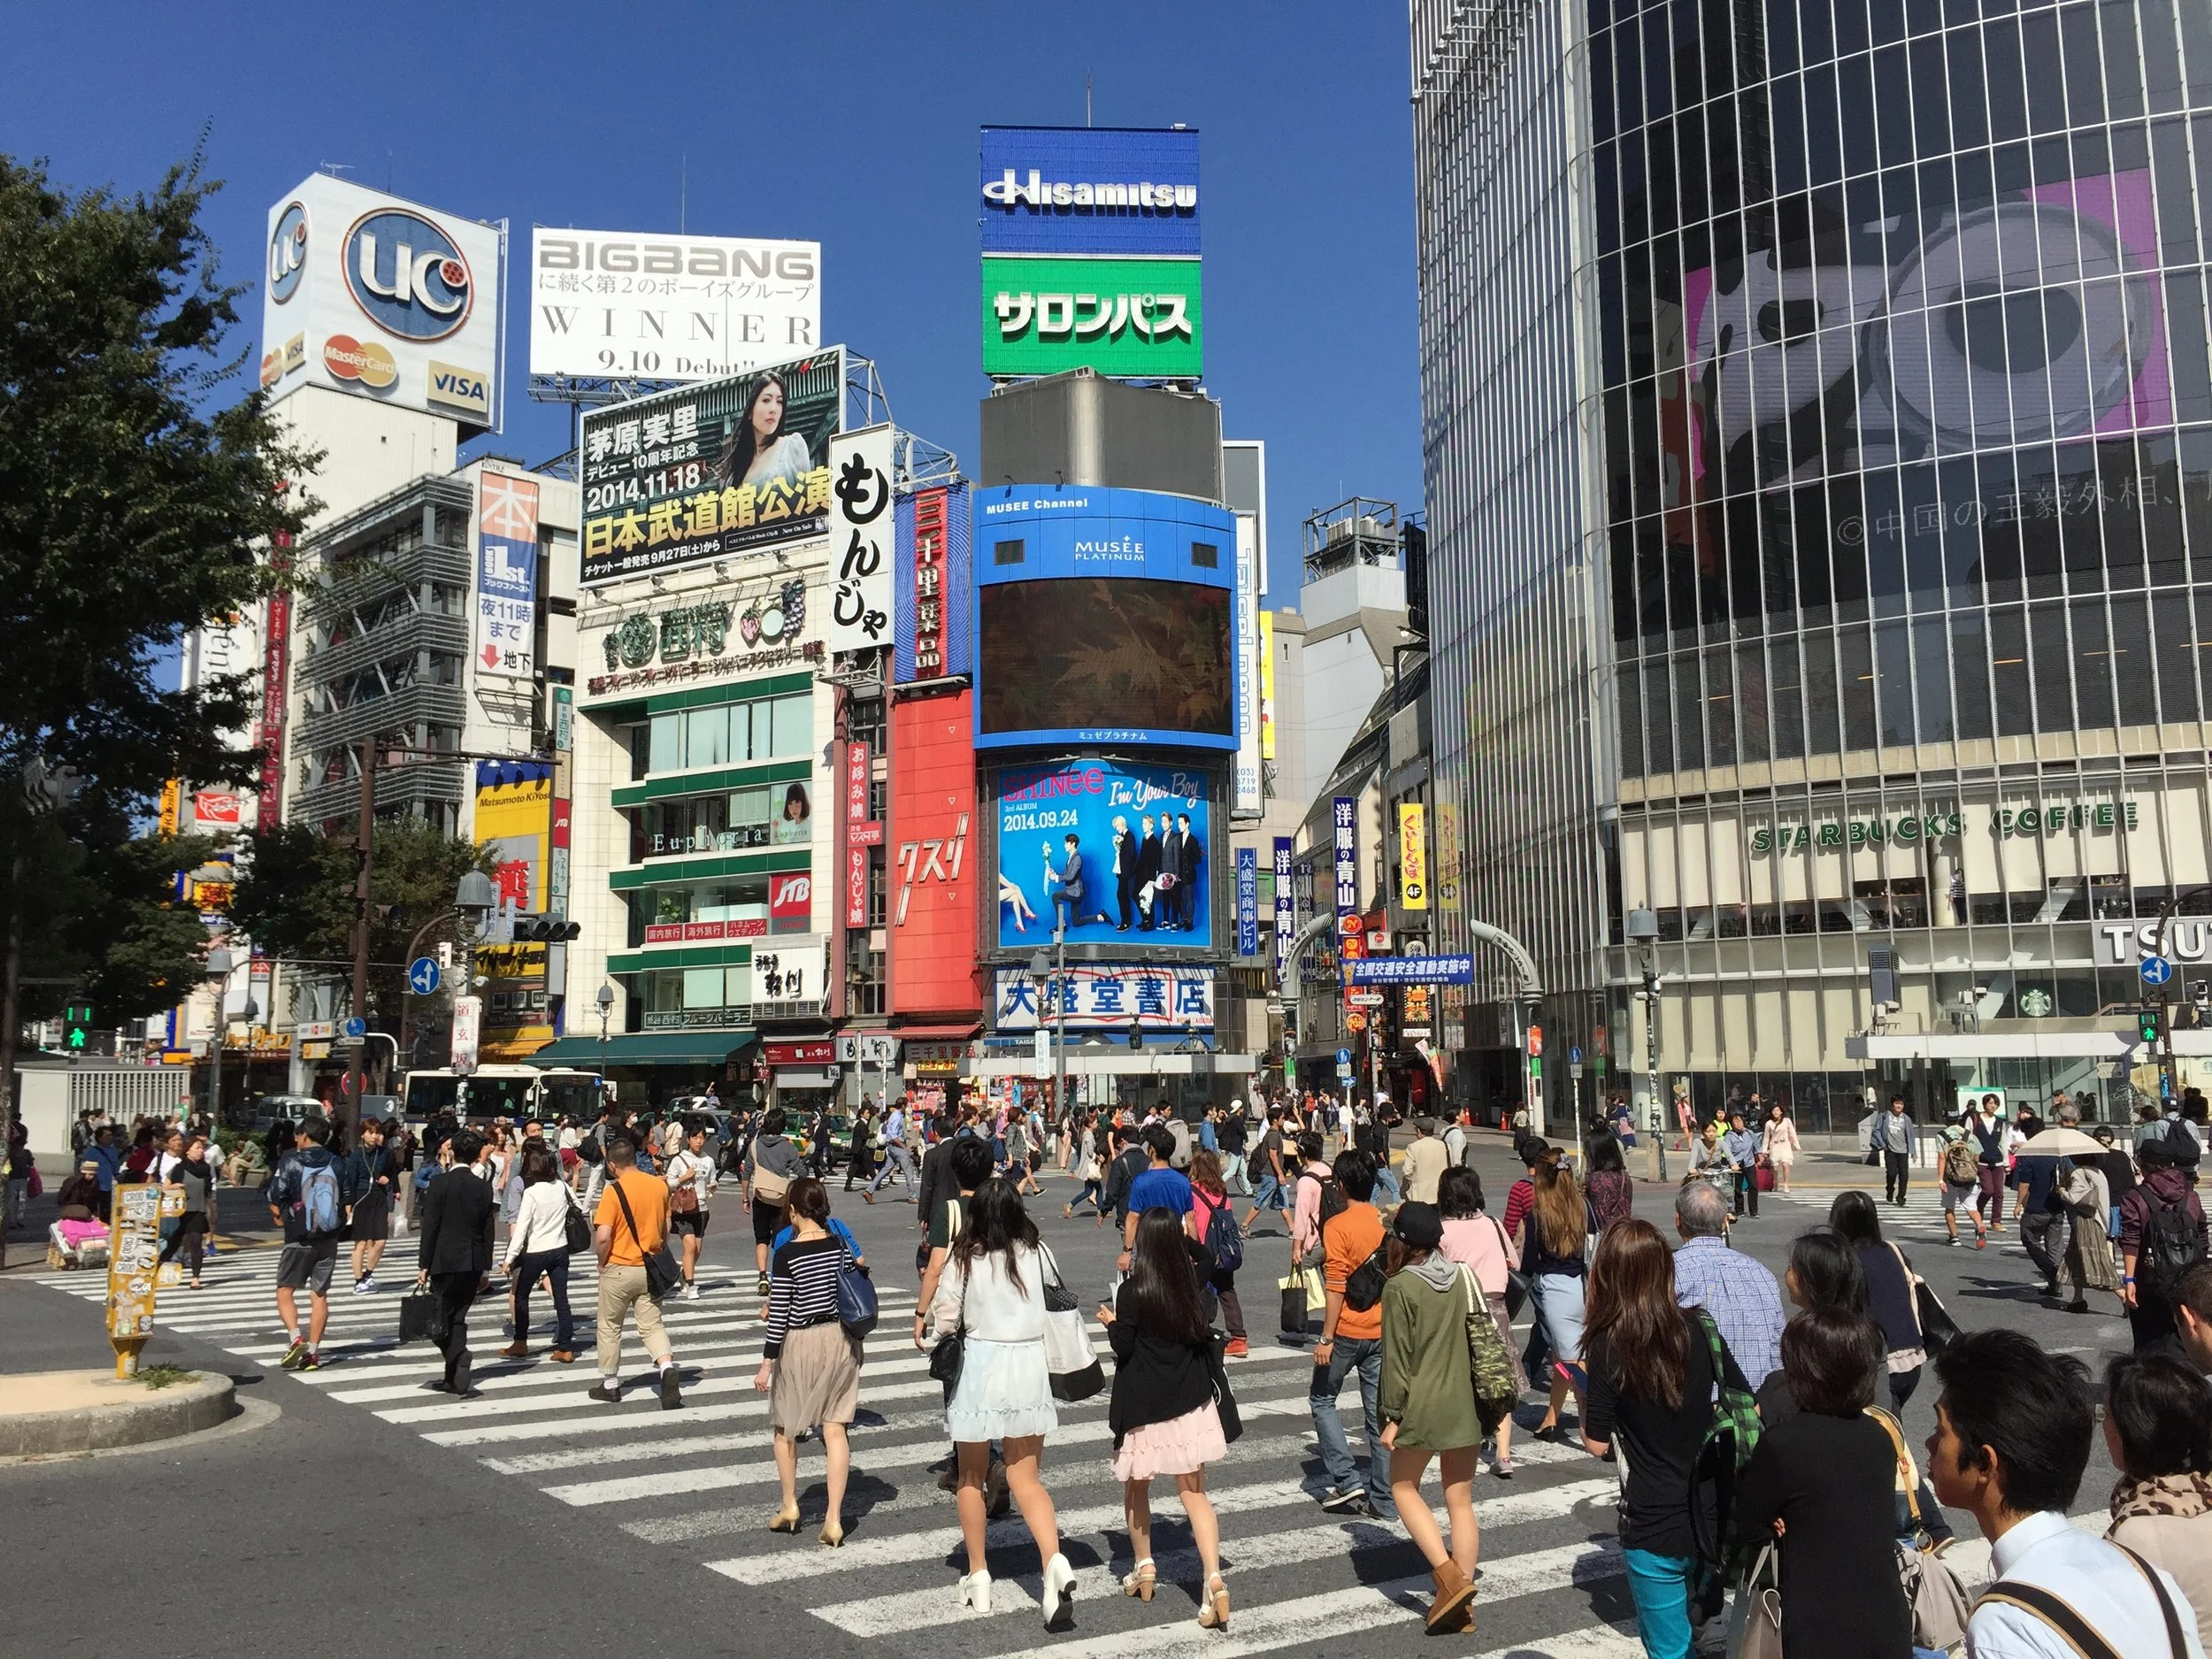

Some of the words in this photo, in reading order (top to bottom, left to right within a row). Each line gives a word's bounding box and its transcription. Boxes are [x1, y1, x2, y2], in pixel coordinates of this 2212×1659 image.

[982, 168, 1196, 207] Hisamitsu
[539, 304, 813, 345] WINNER
[994, 292, 1192, 334] サロンパス
[325, 345, 395, 374] MasterCard
[598, 349, 661, 372] 9.10
[434, 373, 485, 401] VISA
[588, 404, 699, 462] 茅原実里
[587, 464, 700, 513] 2014.11.18
[586, 465, 832, 558] 日本武道館公演
[987, 502, 1029, 514] MUSEE
[1034, 498, 1087, 509] Channel
[484, 546, 494, 575] BOOK
[834, 452, 889, 641] もんじゃ
[484, 577, 531, 593] ブックファースト
[916, 493, 941, 669] 三千里薬品
[480, 598, 532, 624] 夜11時
[489, 621, 521, 641] まで
[503, 650, 531, 671] 地下
[1079, 731, 1148, 741] ミュゼプラチナム
[851, 747, 864, 818] お好み焼
[1003, 767, 1104, 803] SHINee
[1133, 779, 1170, 810] Your
[1171, 772, 1200, 809] Boy
[480, 795, 525, 808] Matsumoto
[1003, 809, 1078, 832] 2014.09.24
[1754, 810, 1967, 852] STARBUCKS
[1993, 801, 2139, 833] COFFEE
[653, 825, 763, 854] Euphoria
[1335, 803, 1355, 907] 洋服の青山
[773, 877, 810, 908] JTB
[850, 850, 864, 924] もんじゃ焼
[1240, 854, 1255, 949] 大盛堂商事ビル
[1276, 849, 1293, 958] 洋服の青山
[1407, 887, 1421, 896] 4F
[648, 928, 680, 940] 国内旅行
[687, 924, 721, 936] 海外旅行
[2103, 923, 2212, 960] TSU
[1356, 959, 1470, 977] 全国交通安全運動実施中
[1006, 977, 1205, 1015] 大盛堂書店
[457, 1004, 469, 1066] 道玄坂
[910, 1045, 976, 1059] 三千里薬品
